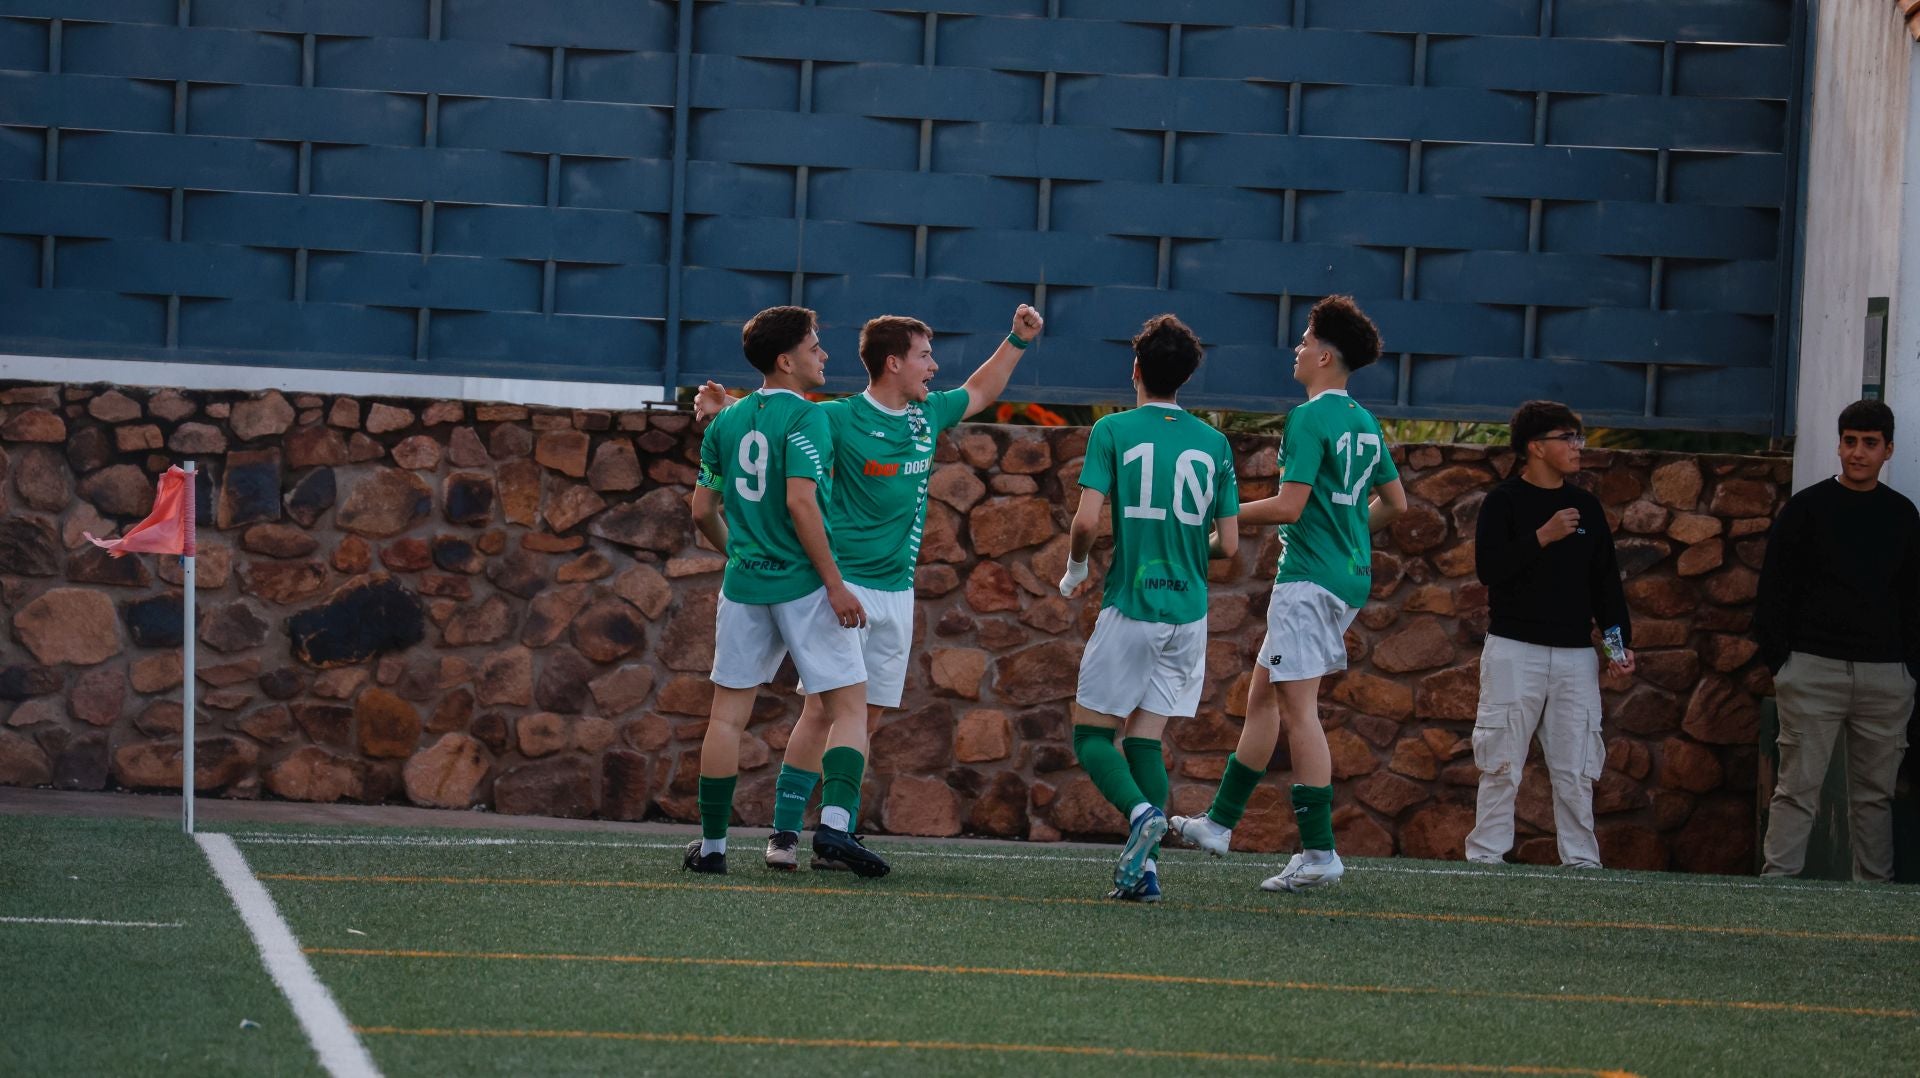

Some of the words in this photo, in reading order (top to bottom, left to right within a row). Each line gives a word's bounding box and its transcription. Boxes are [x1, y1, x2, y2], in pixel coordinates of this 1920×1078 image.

[735, 430, 769, 502] 9
[1123, 442, 1216, 526] 10
[1331, 431, 1381, 506] 17
[737, 559, 786, 571] INPREX
[1144, 578, 1189, 592] INPREX
